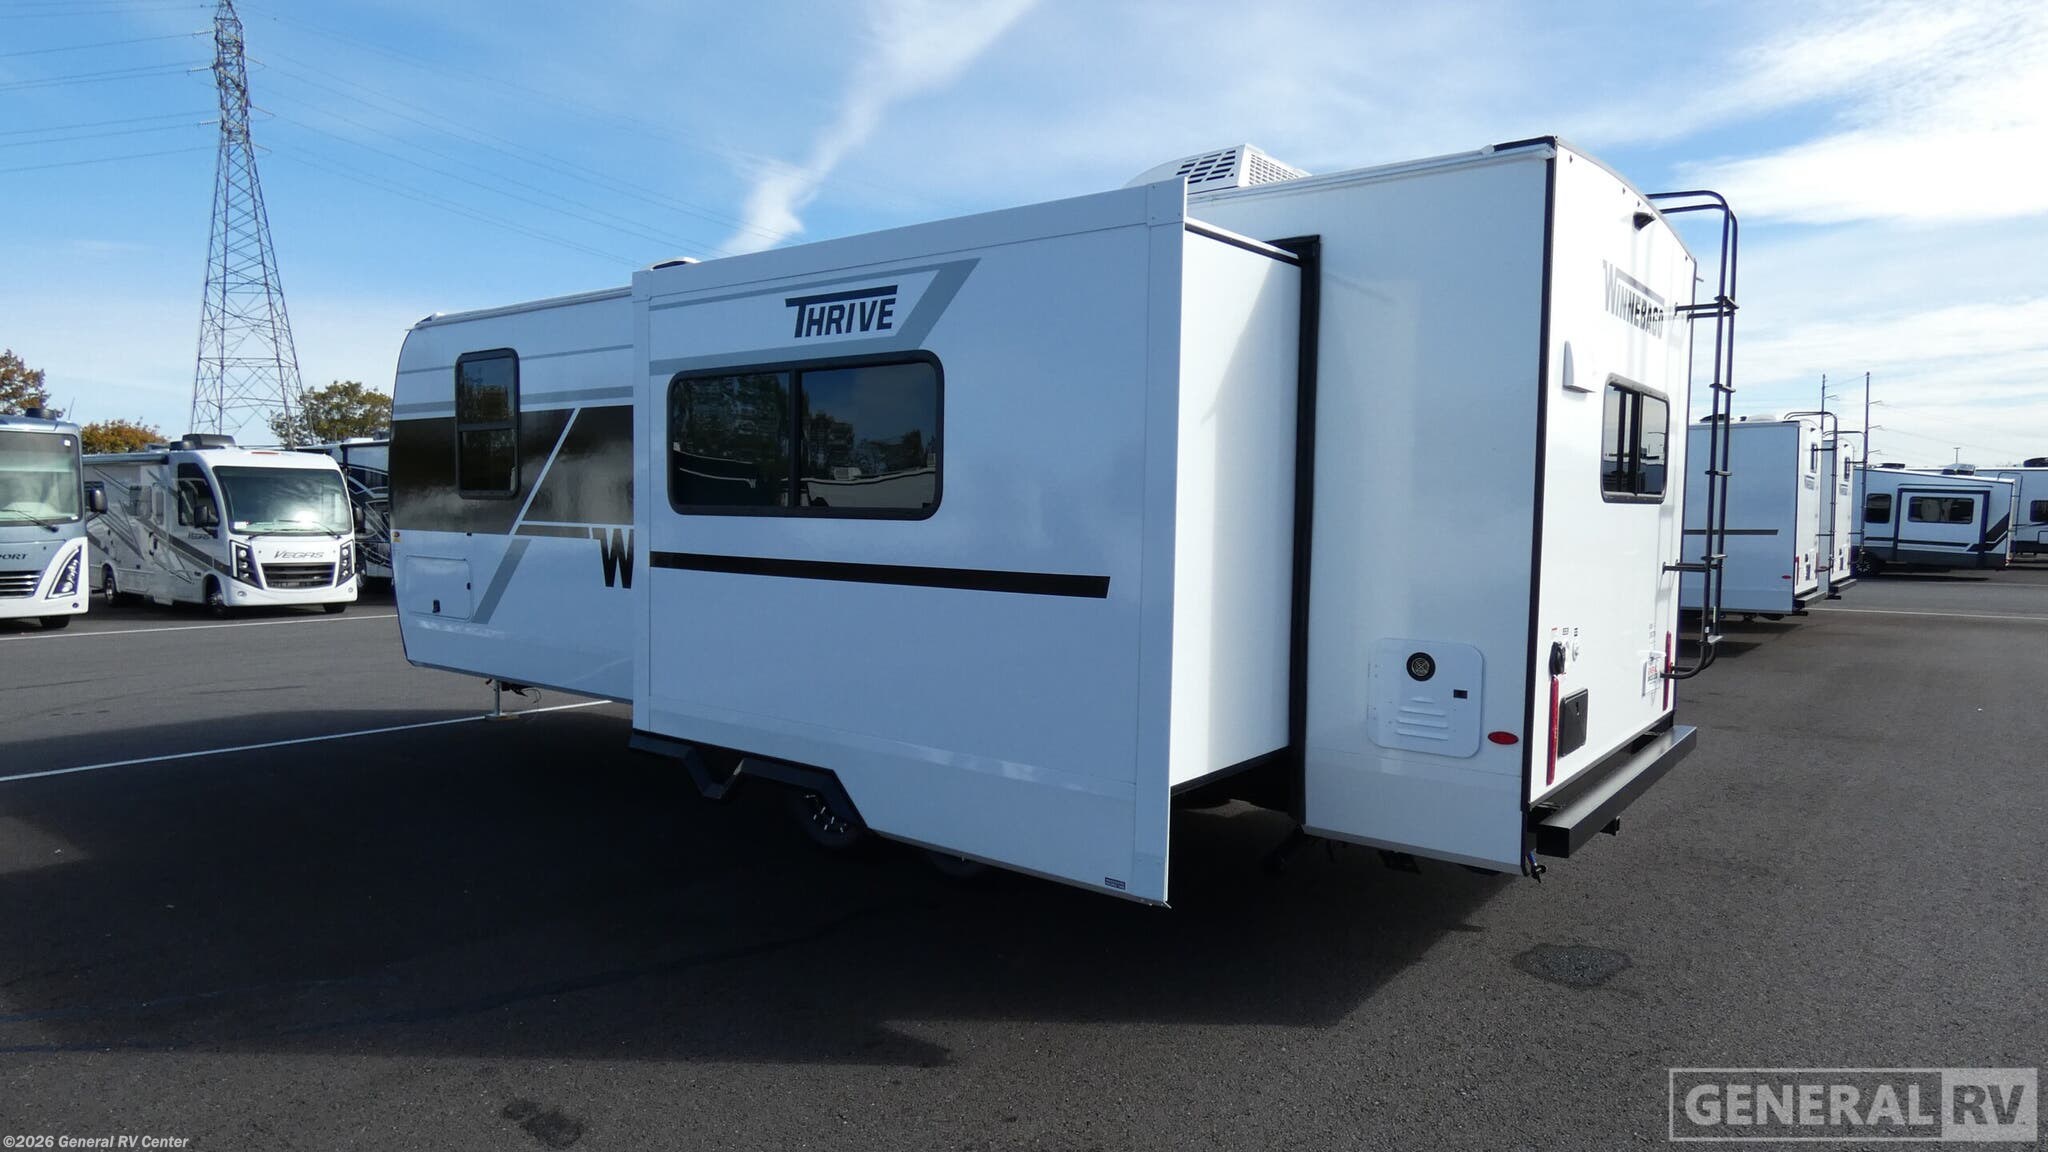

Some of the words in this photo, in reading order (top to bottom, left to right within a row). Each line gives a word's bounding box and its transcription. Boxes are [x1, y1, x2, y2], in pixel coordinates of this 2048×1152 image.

[785, 285, 898, 338] THRIVE
[1602, 258, 1665, 340] WINNEBAGO
[274, 550, 324, 559] VEGAS
